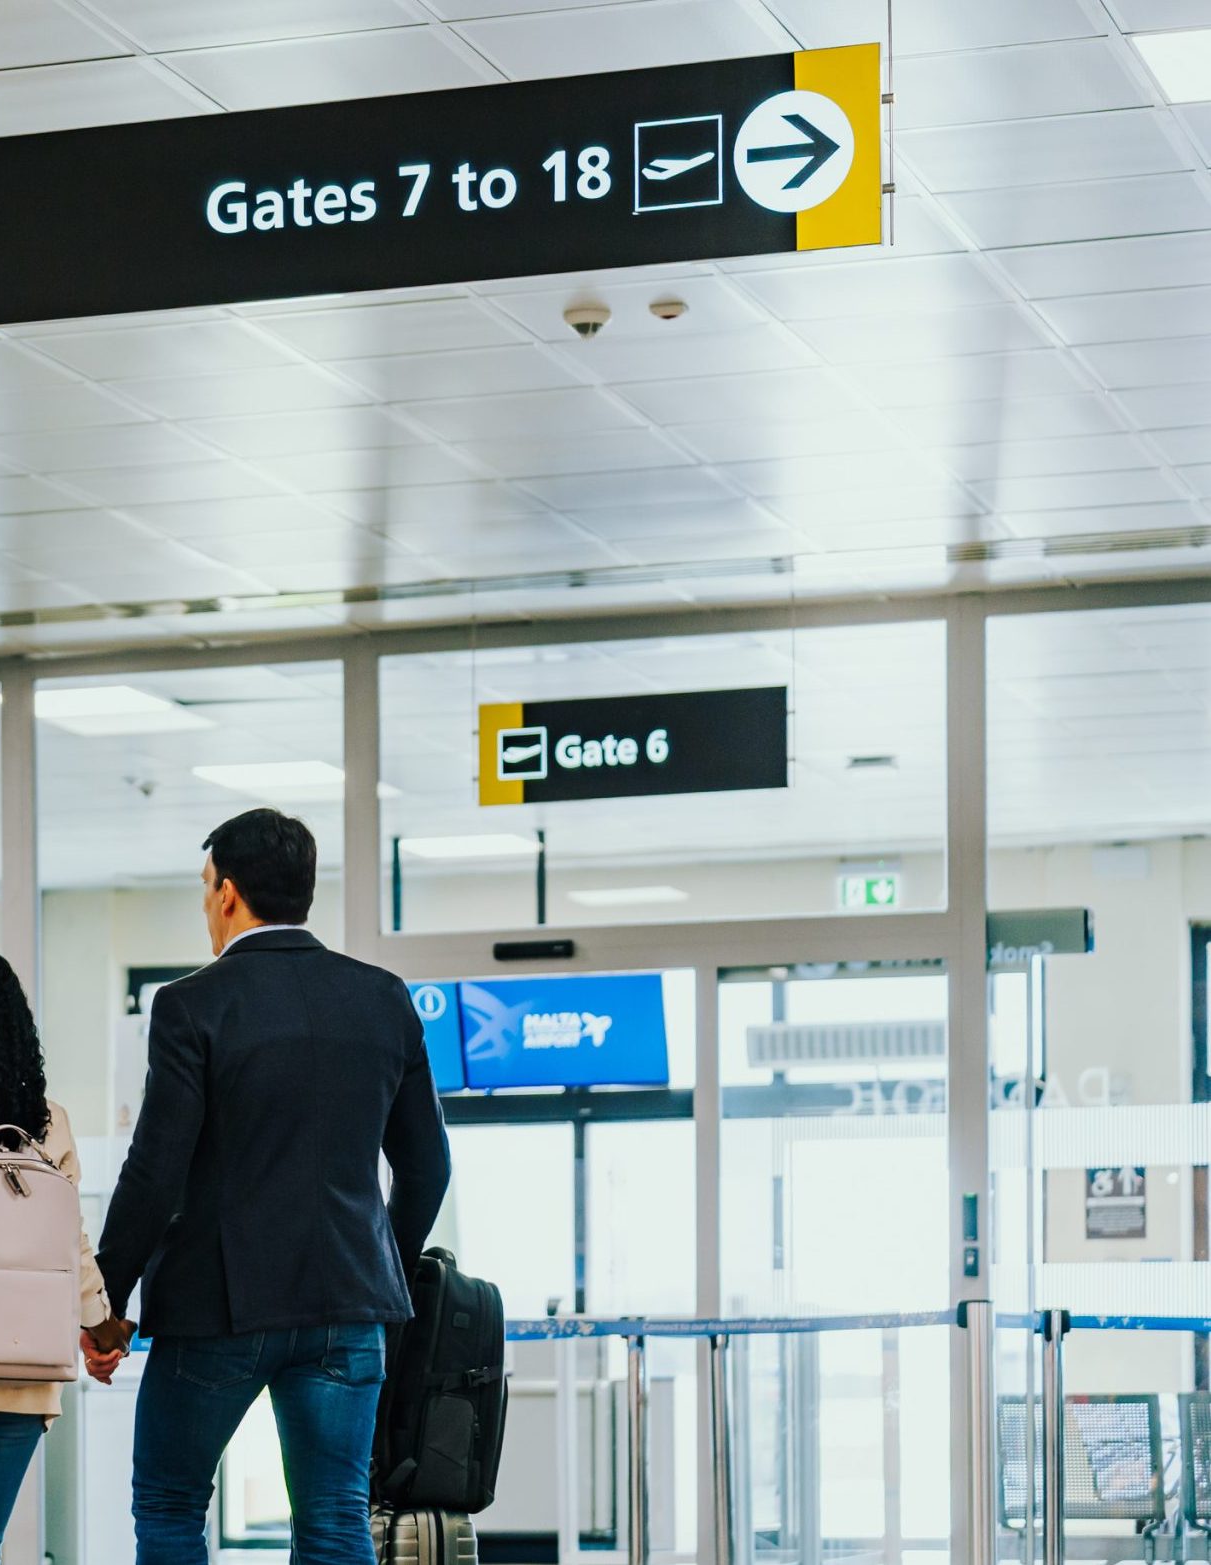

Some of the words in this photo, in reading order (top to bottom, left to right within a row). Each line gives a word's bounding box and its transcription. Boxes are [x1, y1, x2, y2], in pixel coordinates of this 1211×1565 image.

[206, 178, 377, 234] Gates
[398, 164, 431, 217] 7
[451, 162, 518, 212] to
[541, 146, 612, 203] 18
[554, 734, 639, 769] Gate
[645, 728, 669, 764] 6
